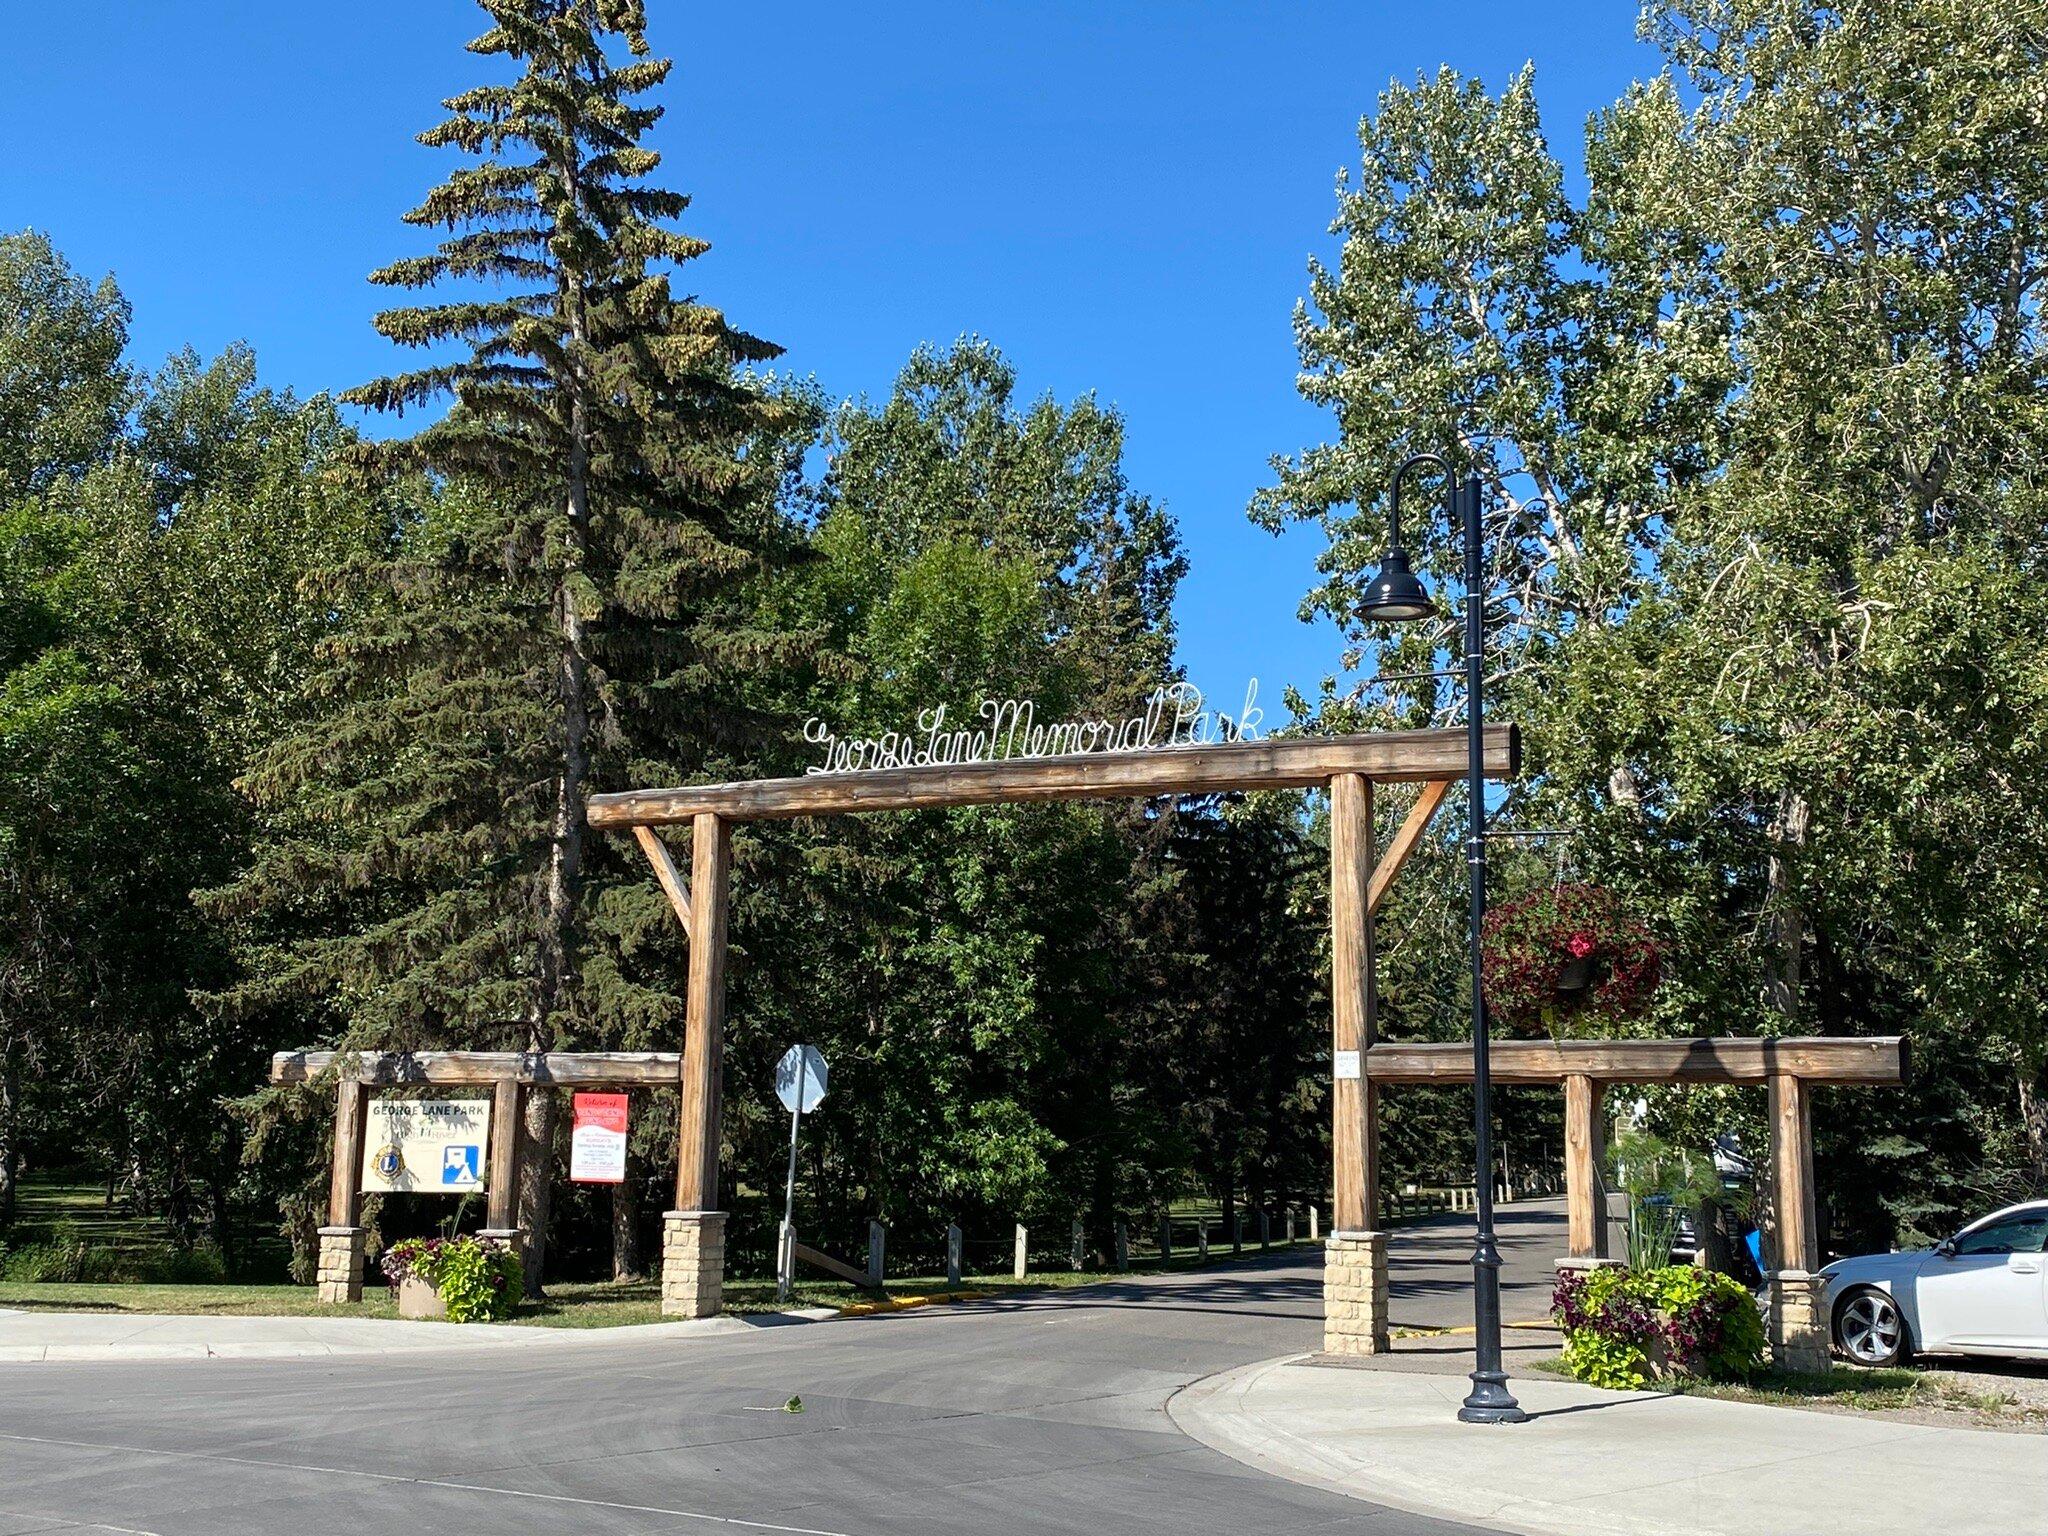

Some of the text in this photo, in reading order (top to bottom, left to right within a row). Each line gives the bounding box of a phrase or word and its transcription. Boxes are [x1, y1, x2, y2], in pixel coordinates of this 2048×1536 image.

[803, 677, 1265, 776] George Lane Memorial Park
[373, 1105, 485, 1116] GEORGE LANE PARK
